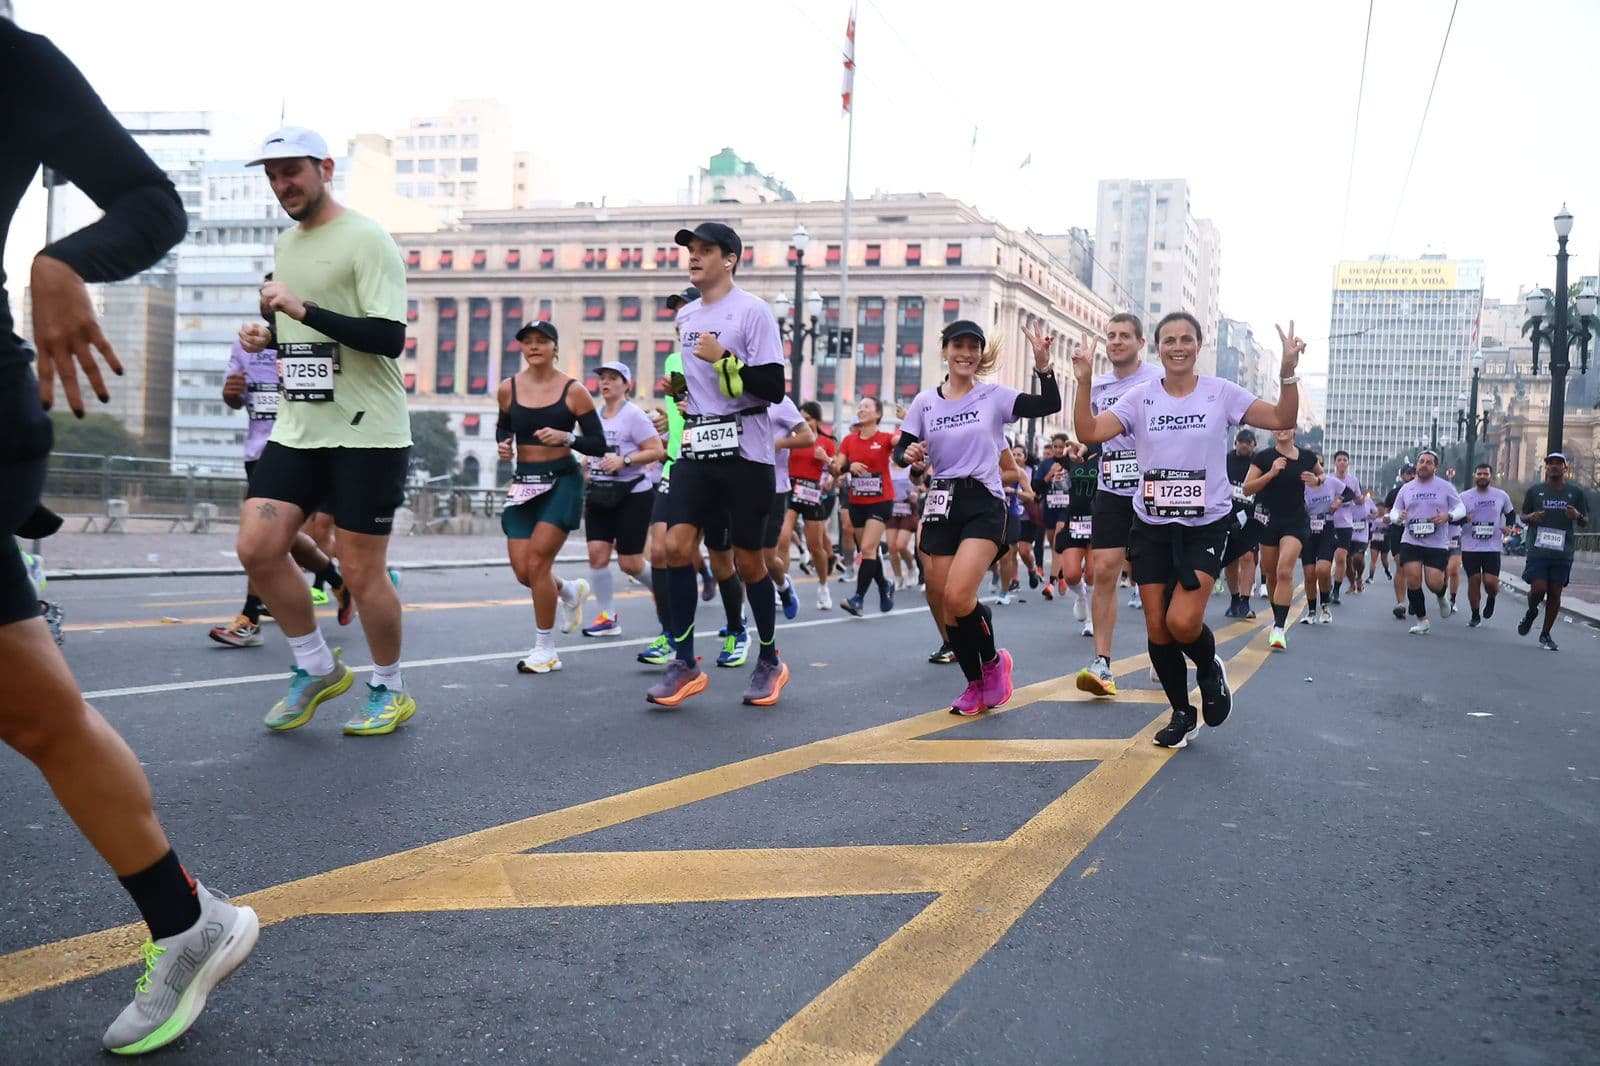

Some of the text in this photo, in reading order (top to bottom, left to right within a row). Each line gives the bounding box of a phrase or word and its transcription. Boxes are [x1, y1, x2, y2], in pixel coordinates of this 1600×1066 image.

[286, 364, 328, 378] 17258
[936, 410, 979, 426] SPCITY
[1157, 414, 1206, 425] SPCITY
[1167, 423, 1206, 431] MARATHON
[696, 427, 734, 443] 14874
[1104, 463, 1109, 471] E
[1147, 484, 1153, 493] E
[1160, 485, 1202, 498] 17238
